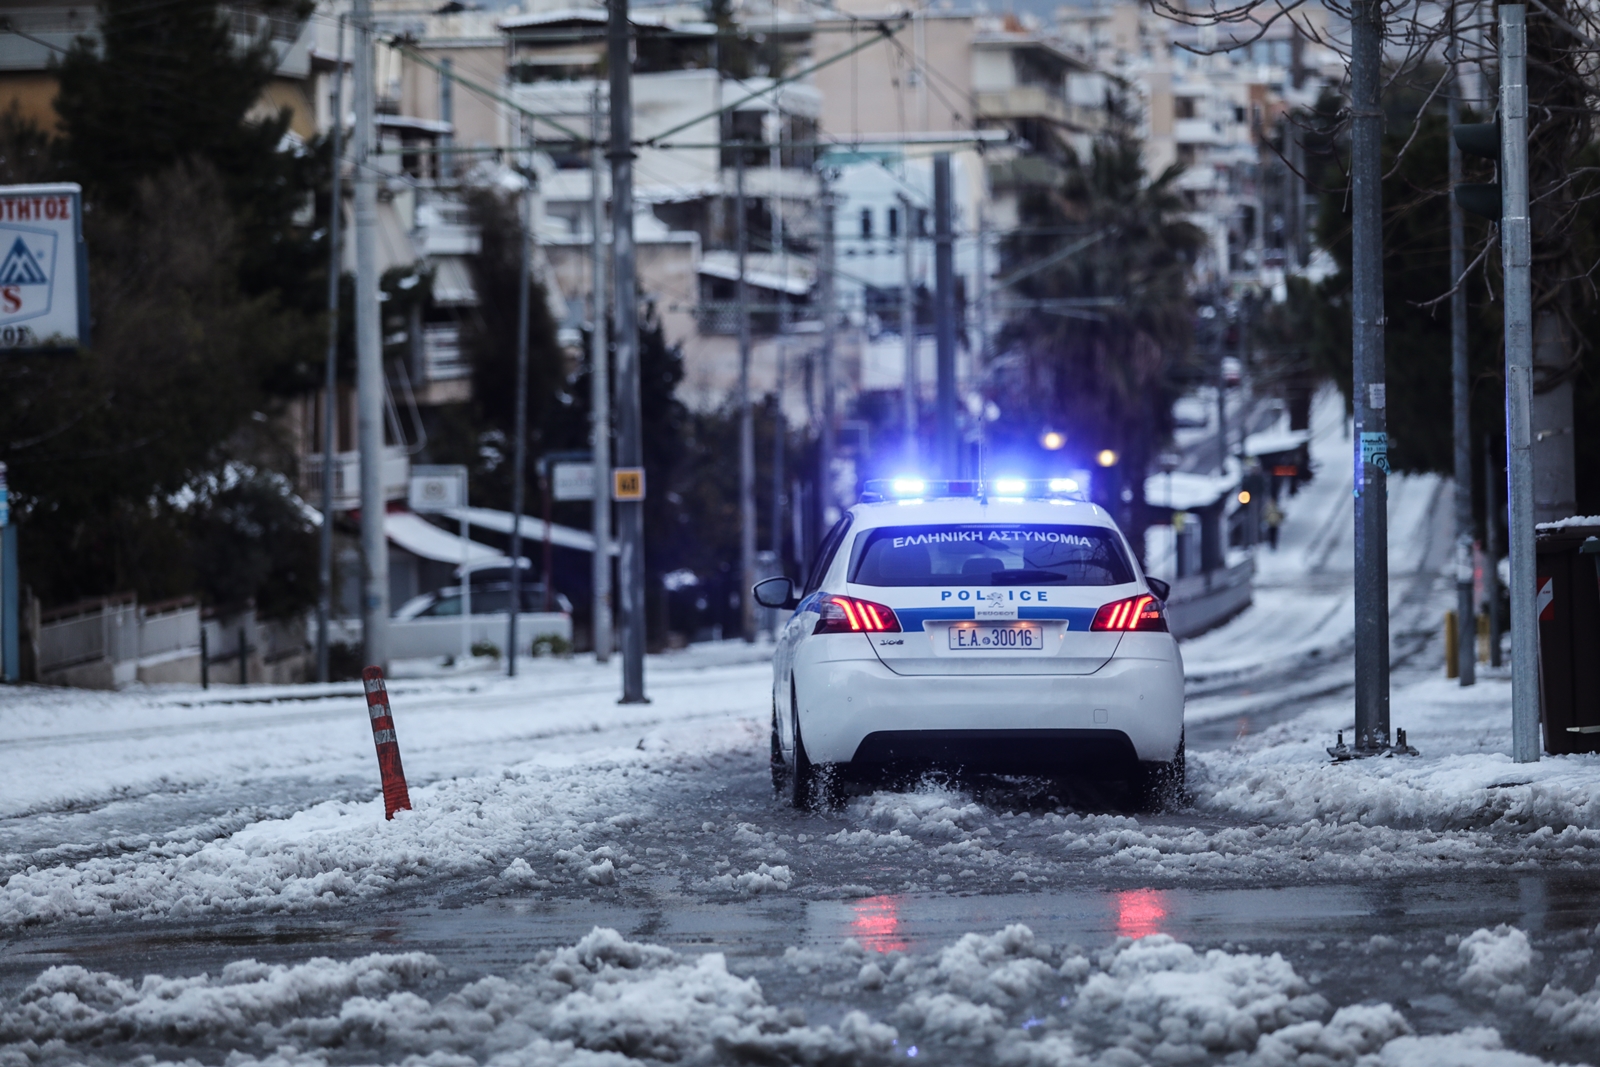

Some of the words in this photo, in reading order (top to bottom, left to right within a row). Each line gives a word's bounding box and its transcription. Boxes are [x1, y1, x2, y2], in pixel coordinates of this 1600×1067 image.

[893, 531, 983, 548] ΕΛΛΗΝΙΚΗ
[988, 531, 1091, 547] ΑΣΤΥΝΟΜΙΑ
[941, 590, 1048, 602] POLICE
[992, 629, 1032, 647] 30016
